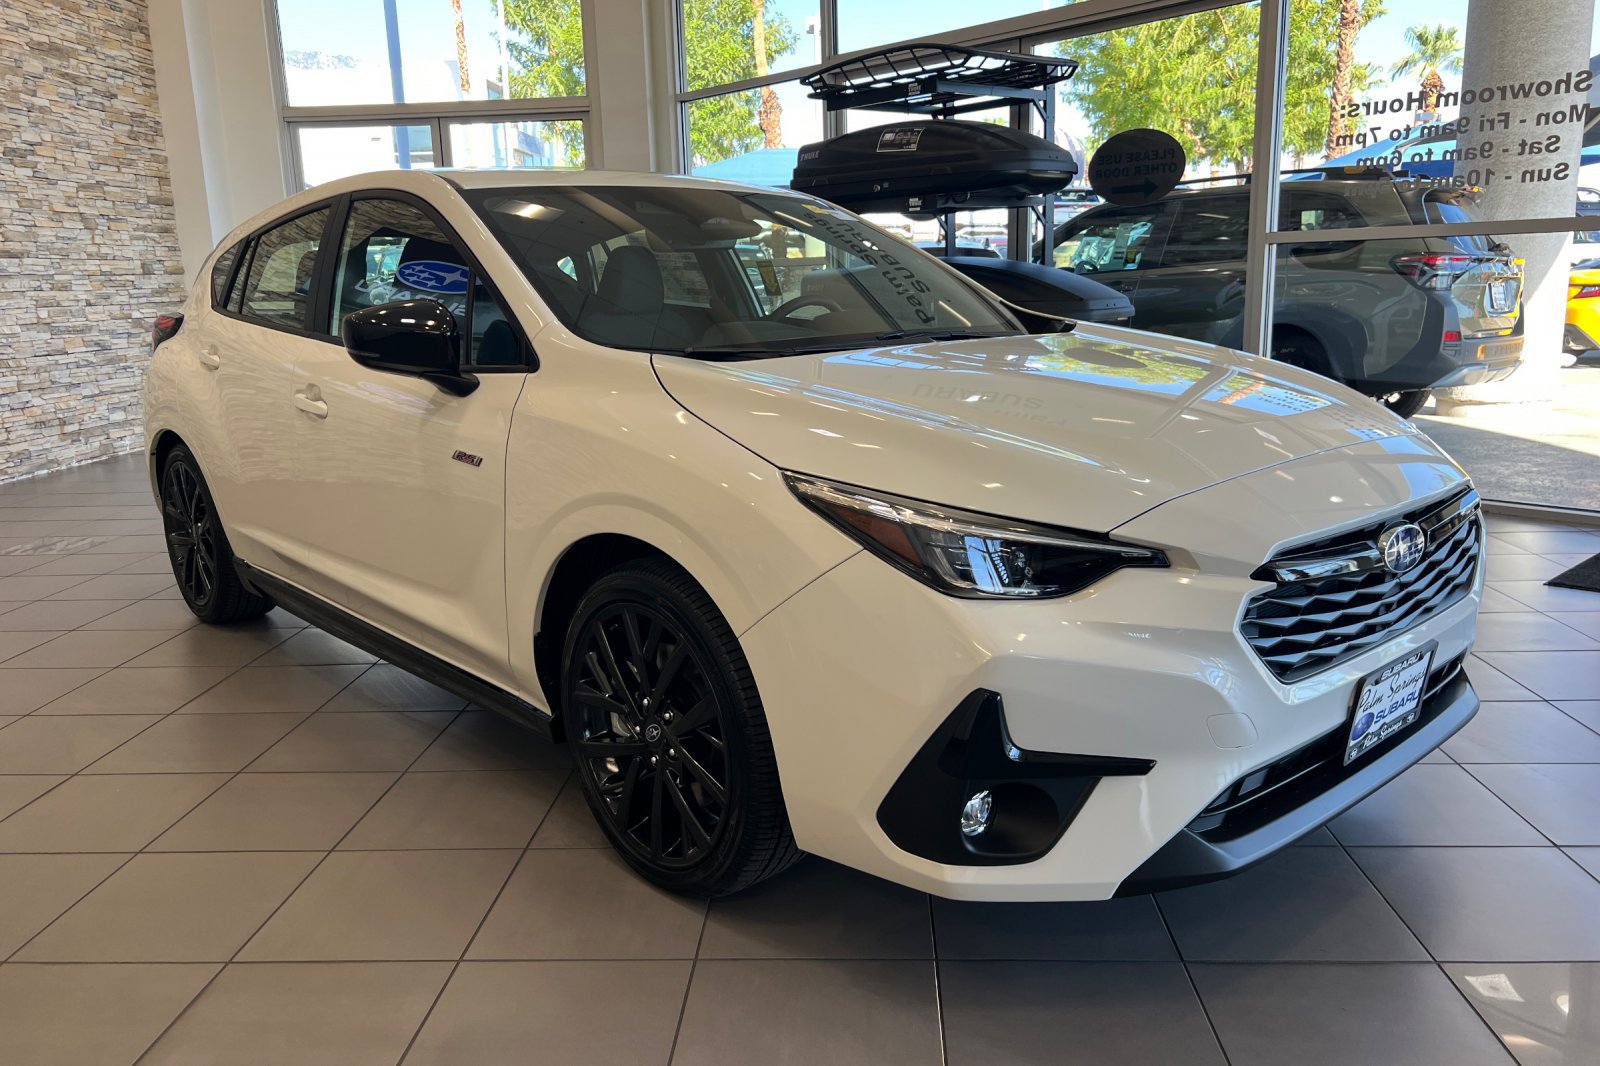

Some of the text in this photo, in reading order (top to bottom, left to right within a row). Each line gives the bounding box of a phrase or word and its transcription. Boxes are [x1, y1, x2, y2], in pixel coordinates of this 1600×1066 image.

[836, 222, 932, 293] SUBARU
[1382, 652, 1421, 681] SUBARU
[1359, 668, 1427, 713] Palm Springs
[1374, 690, 1420, 725] SUBARU
